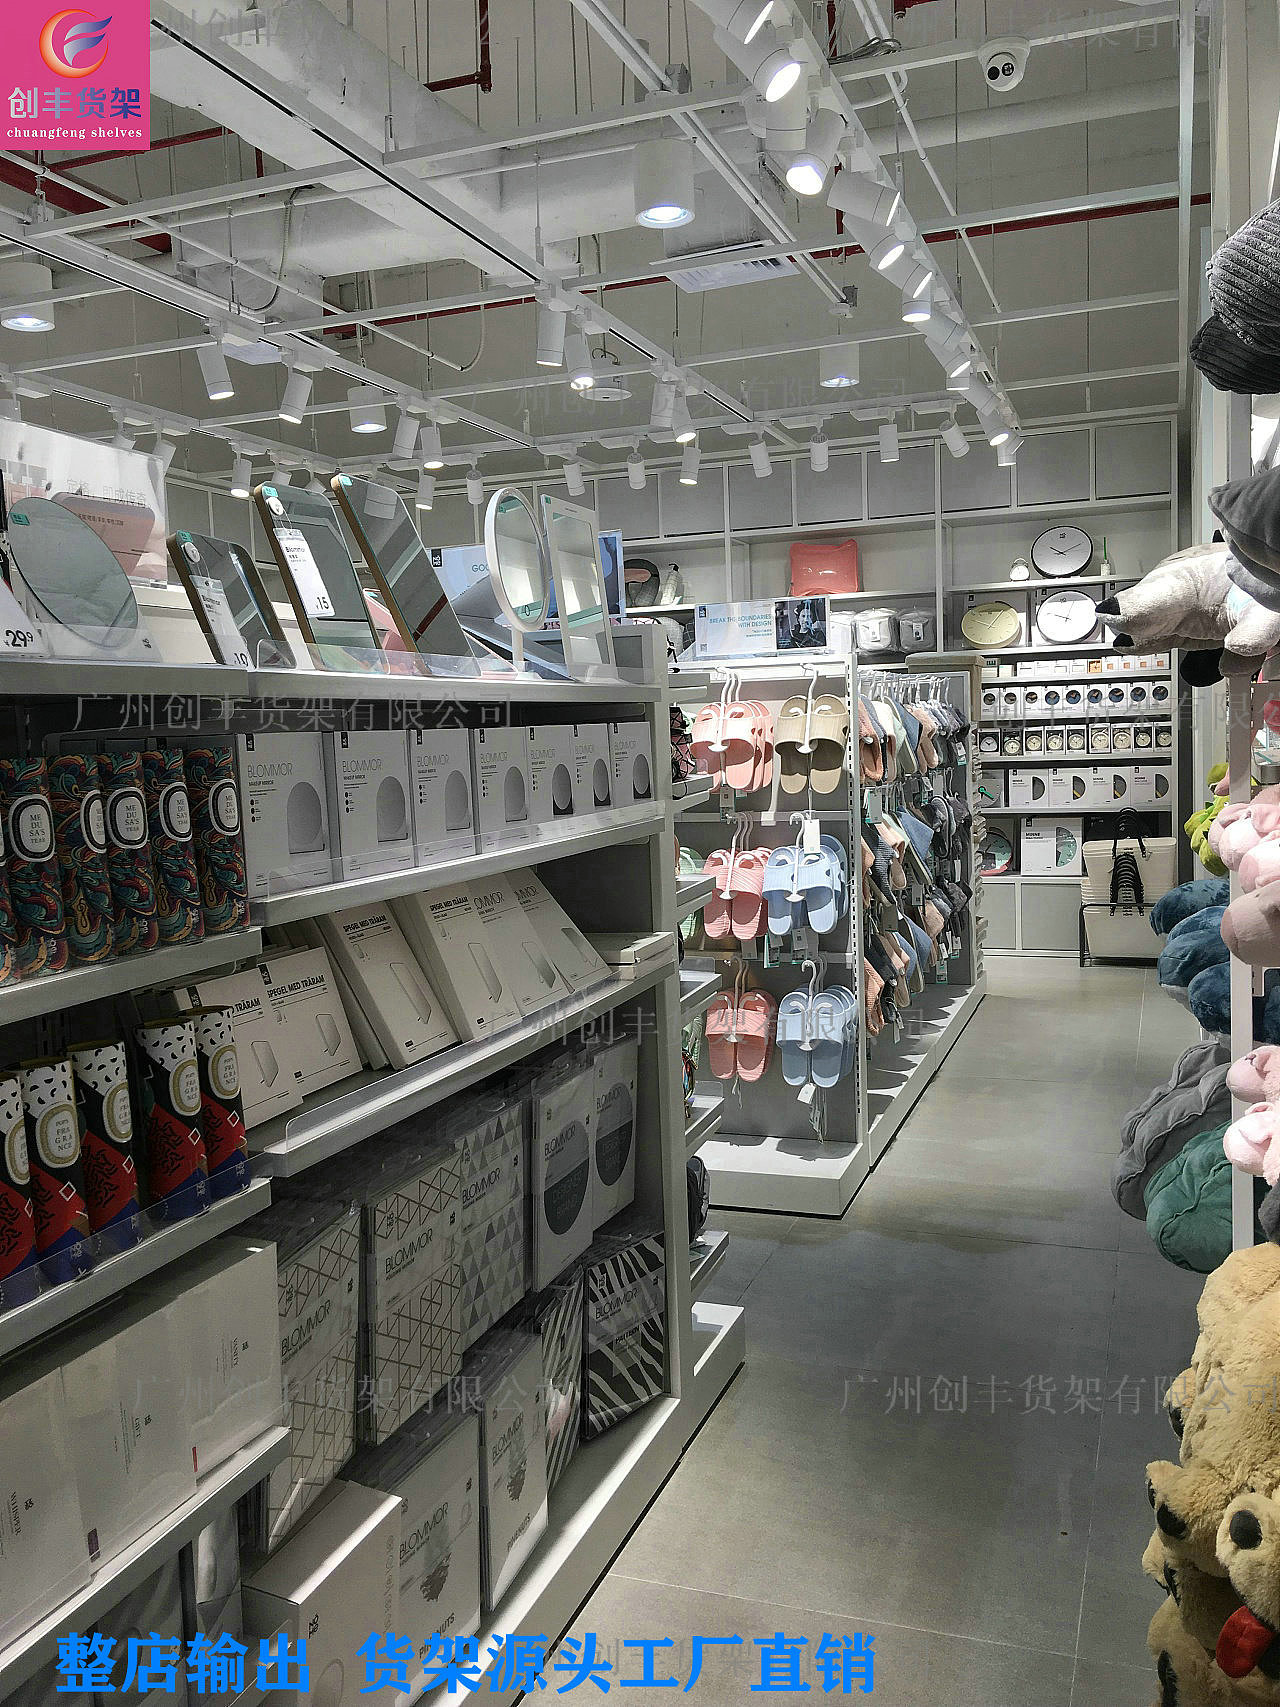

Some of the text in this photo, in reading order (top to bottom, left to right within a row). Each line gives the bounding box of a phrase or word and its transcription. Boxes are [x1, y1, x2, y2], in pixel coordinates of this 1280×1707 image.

[247, 762, 293, 778] BLOMMOR
[341, 758, 383, 773] BLOMMOR
[473, 891, 504, 911] OMMOR
[289, 982, 301, 993] MED
[462, 1167, 500, 1205] BLOMMOR
[385, 1227, 433, 1274] BLOMMOR
[595, 1287, 638, 1320] BLOMMOR
[281, 1299, 331, 1358] BLOMMOR
[399, 1502, 449, 1560] BLOMMOR
